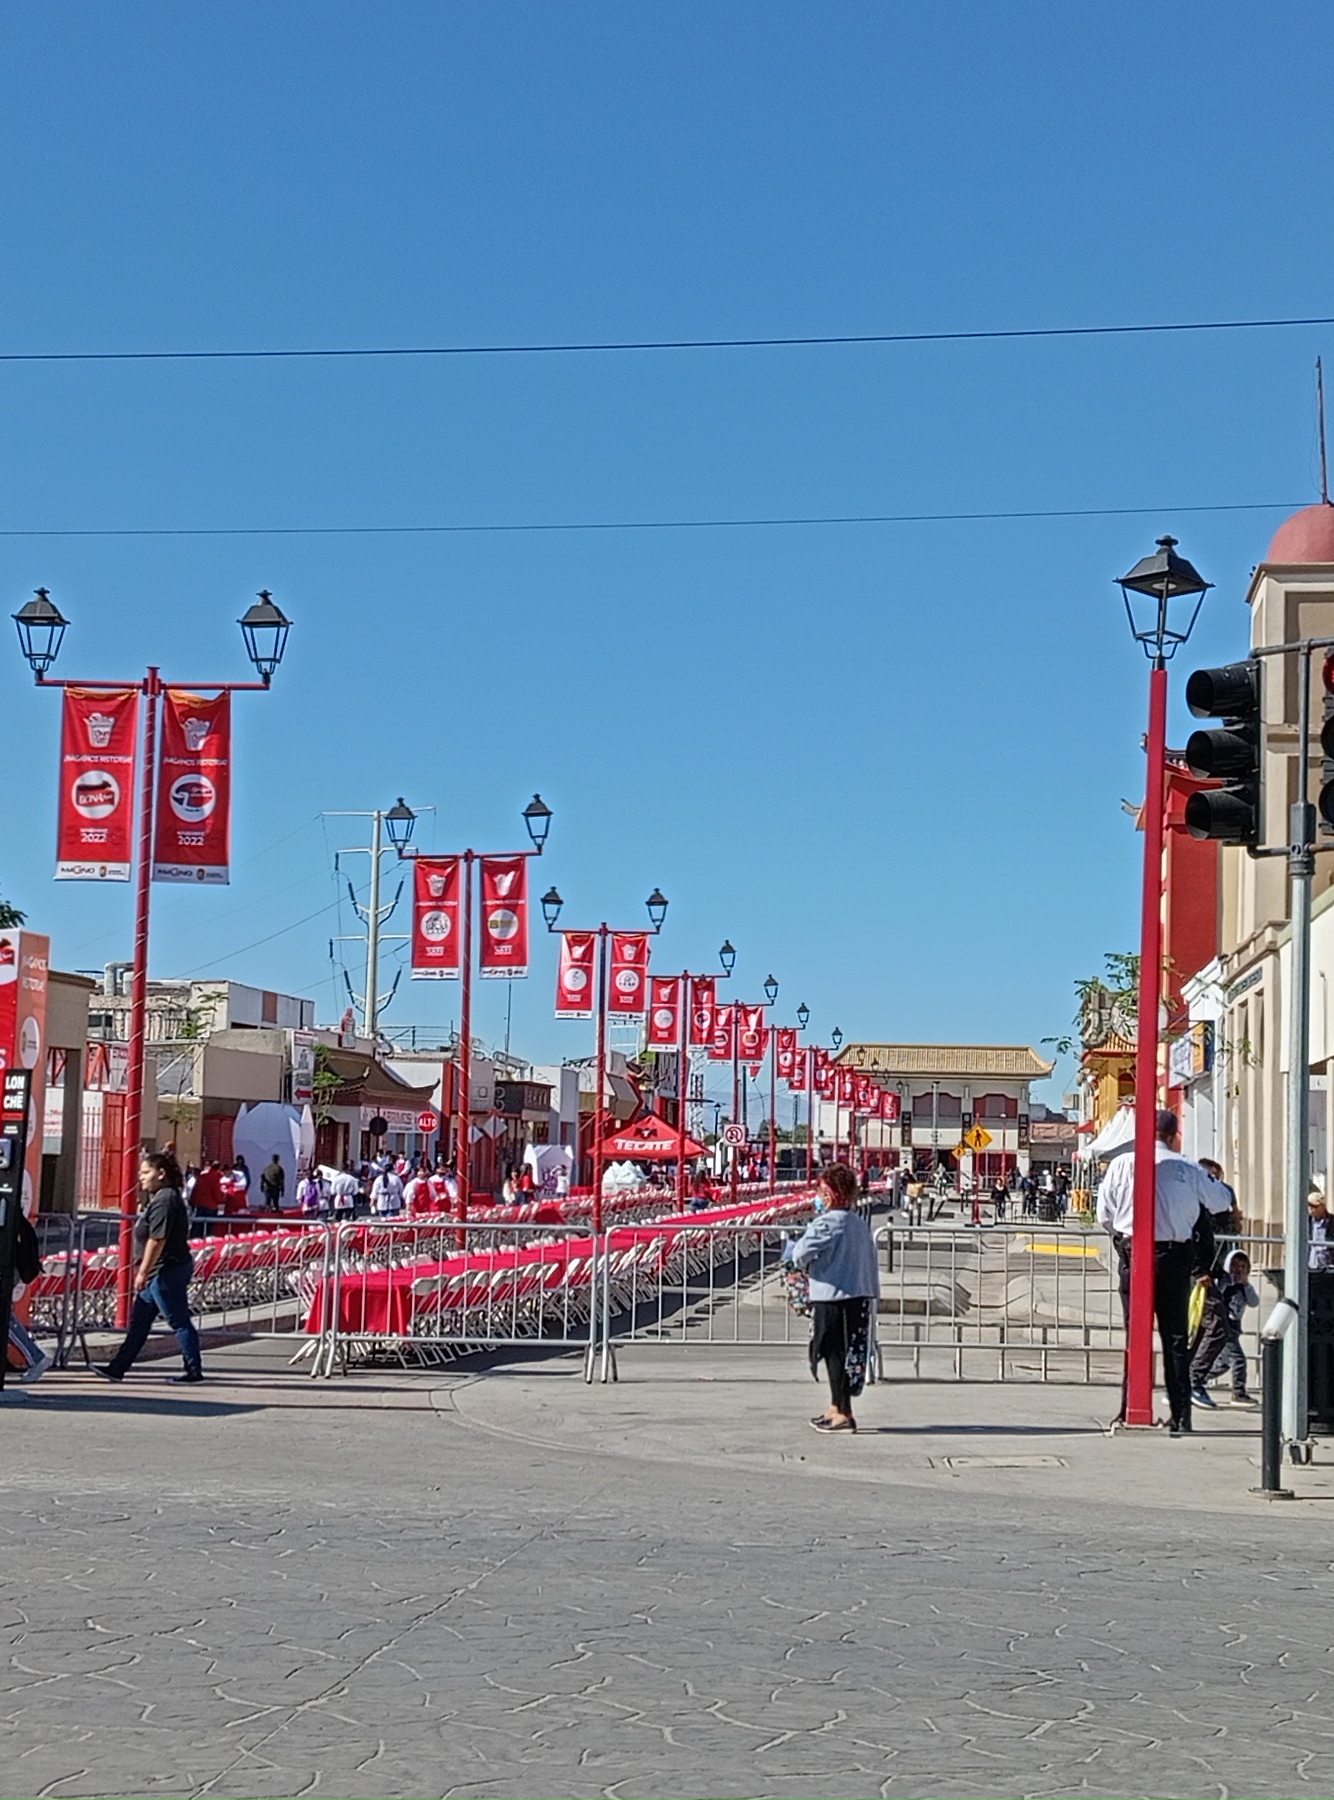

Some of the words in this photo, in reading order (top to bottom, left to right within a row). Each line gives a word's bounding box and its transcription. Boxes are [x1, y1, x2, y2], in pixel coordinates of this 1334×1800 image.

[81, 833, 108, 843] 2022
[178, 836, 205, 846] 2022
[5, 1075, 25, 1090] LON
[418, 1117, 437, 1128] ALTO
[613, 1138, 677, 1151] TECATE
